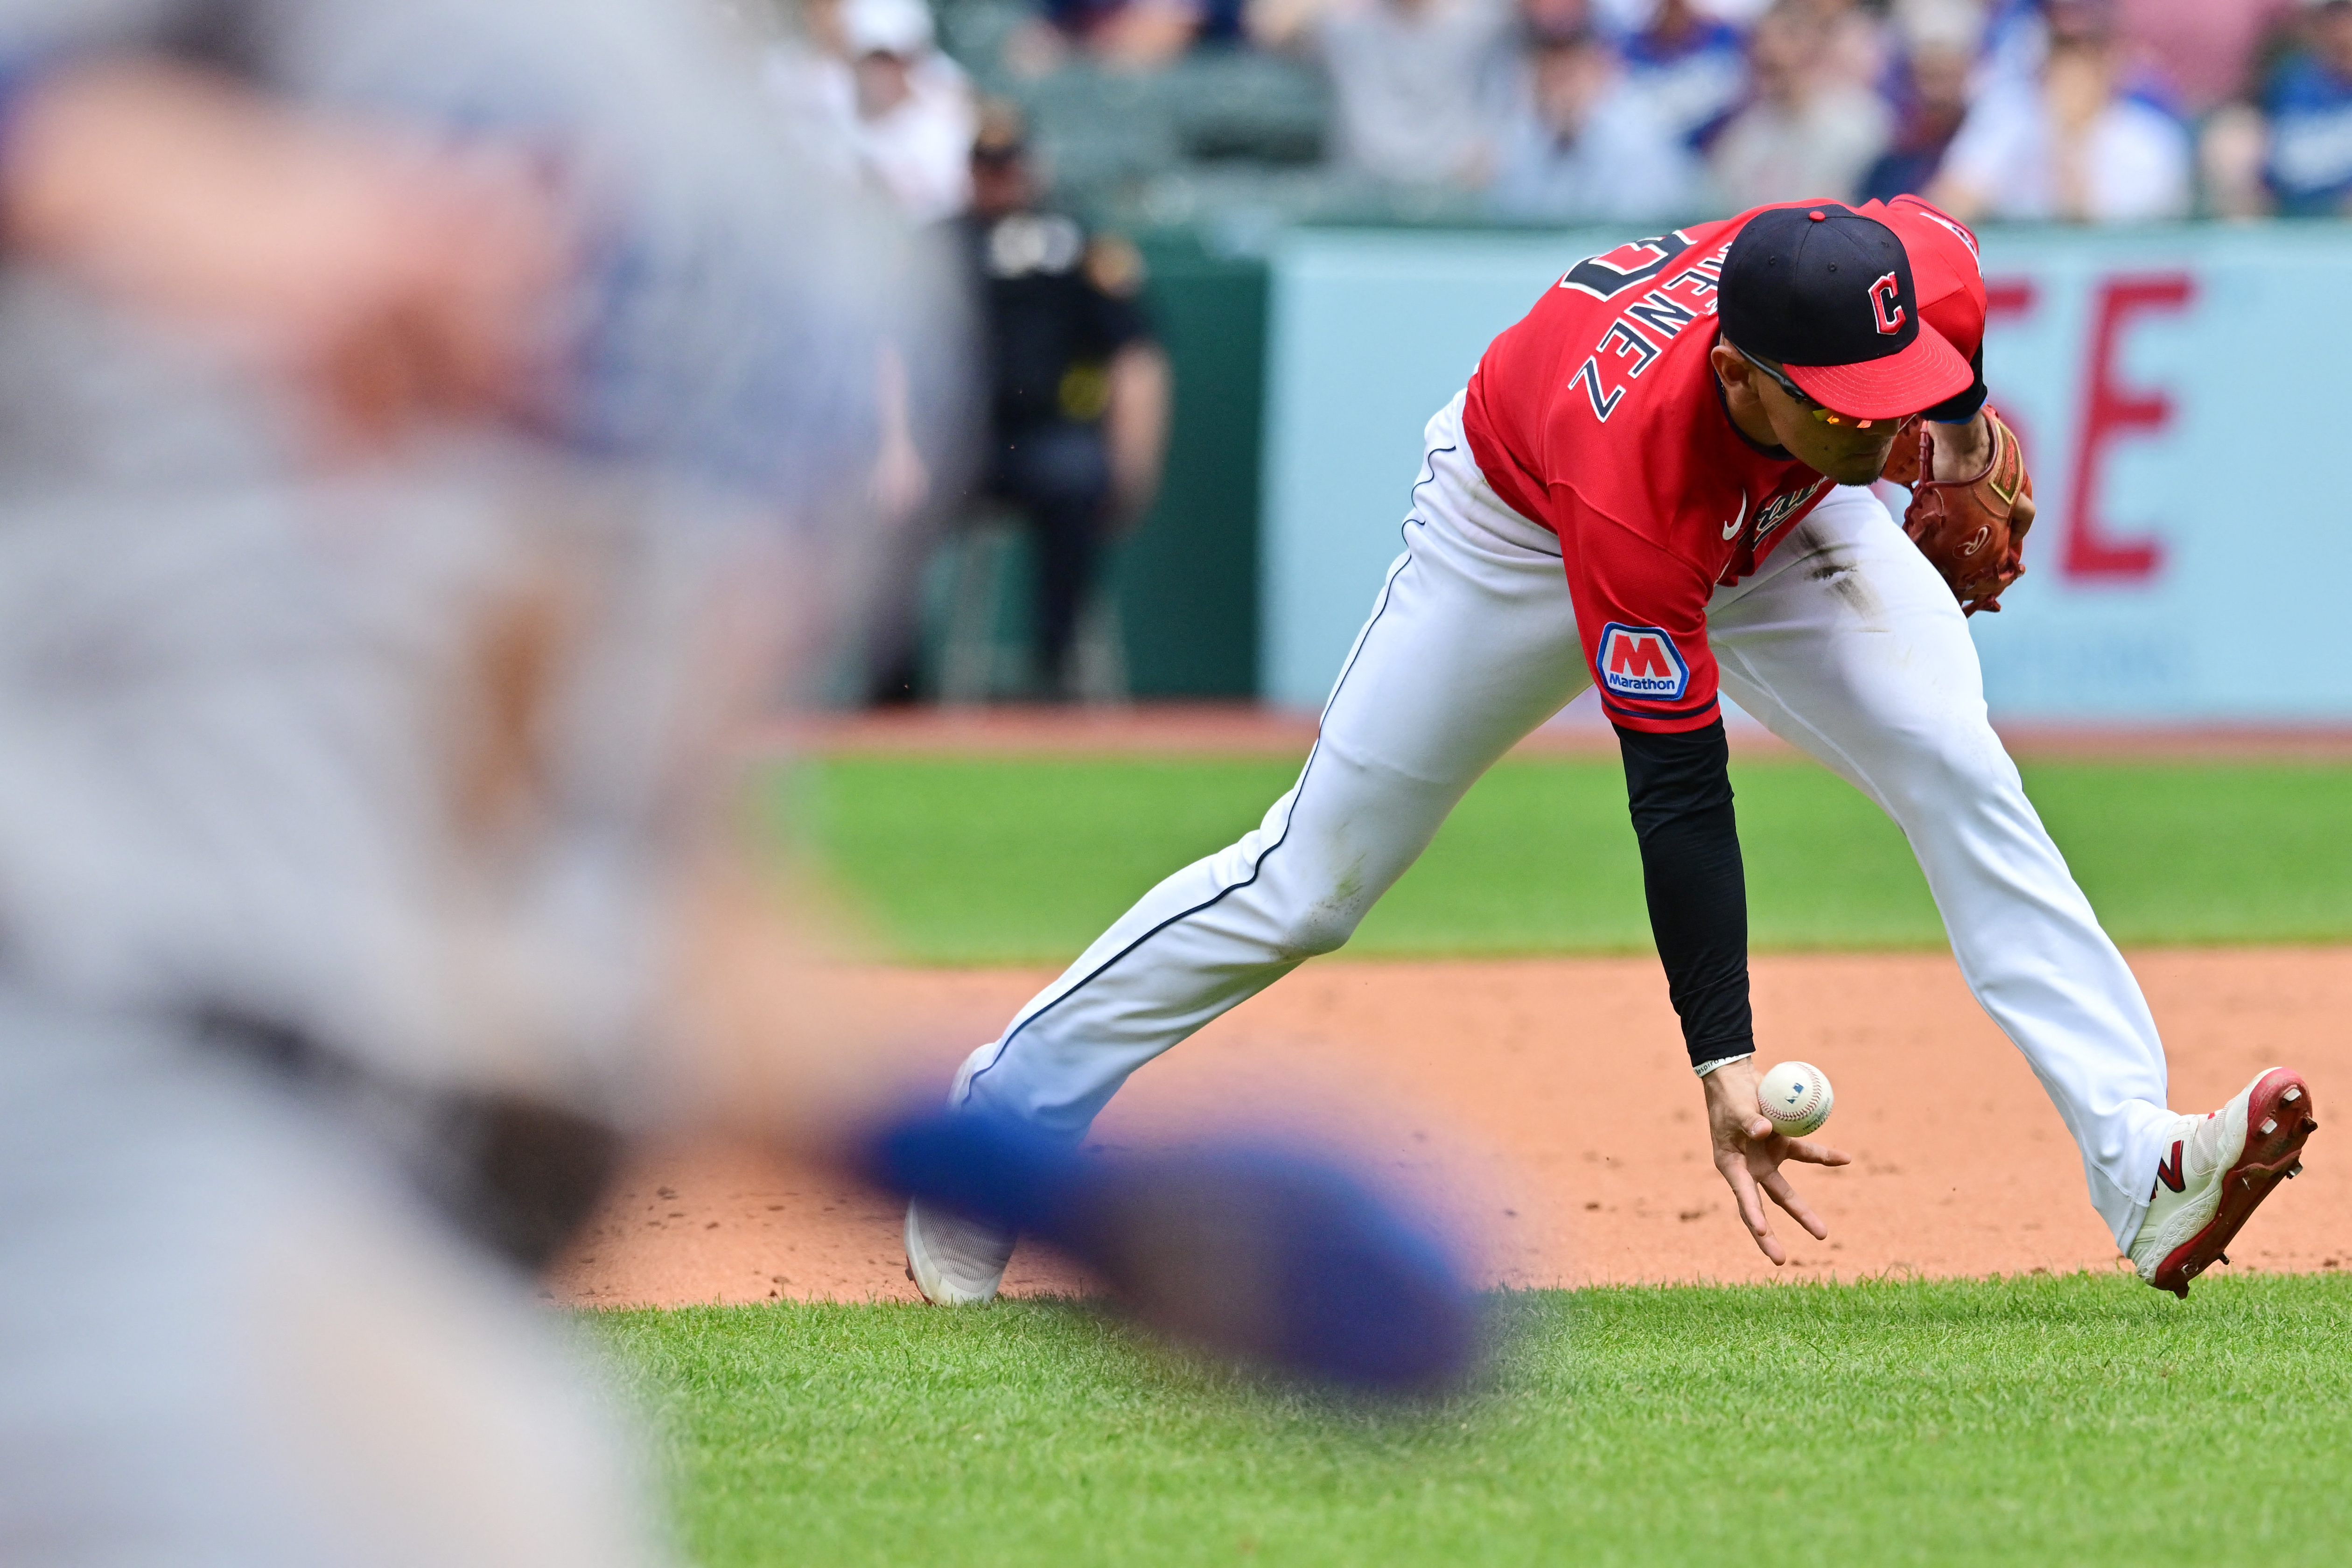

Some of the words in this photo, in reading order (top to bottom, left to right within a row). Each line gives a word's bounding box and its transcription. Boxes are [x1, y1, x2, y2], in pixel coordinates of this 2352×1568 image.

[1868, 271, 1906, 336] C
[1610, 634, 1672, 678] M
[1610, 673, 1675, 690] Marathon
